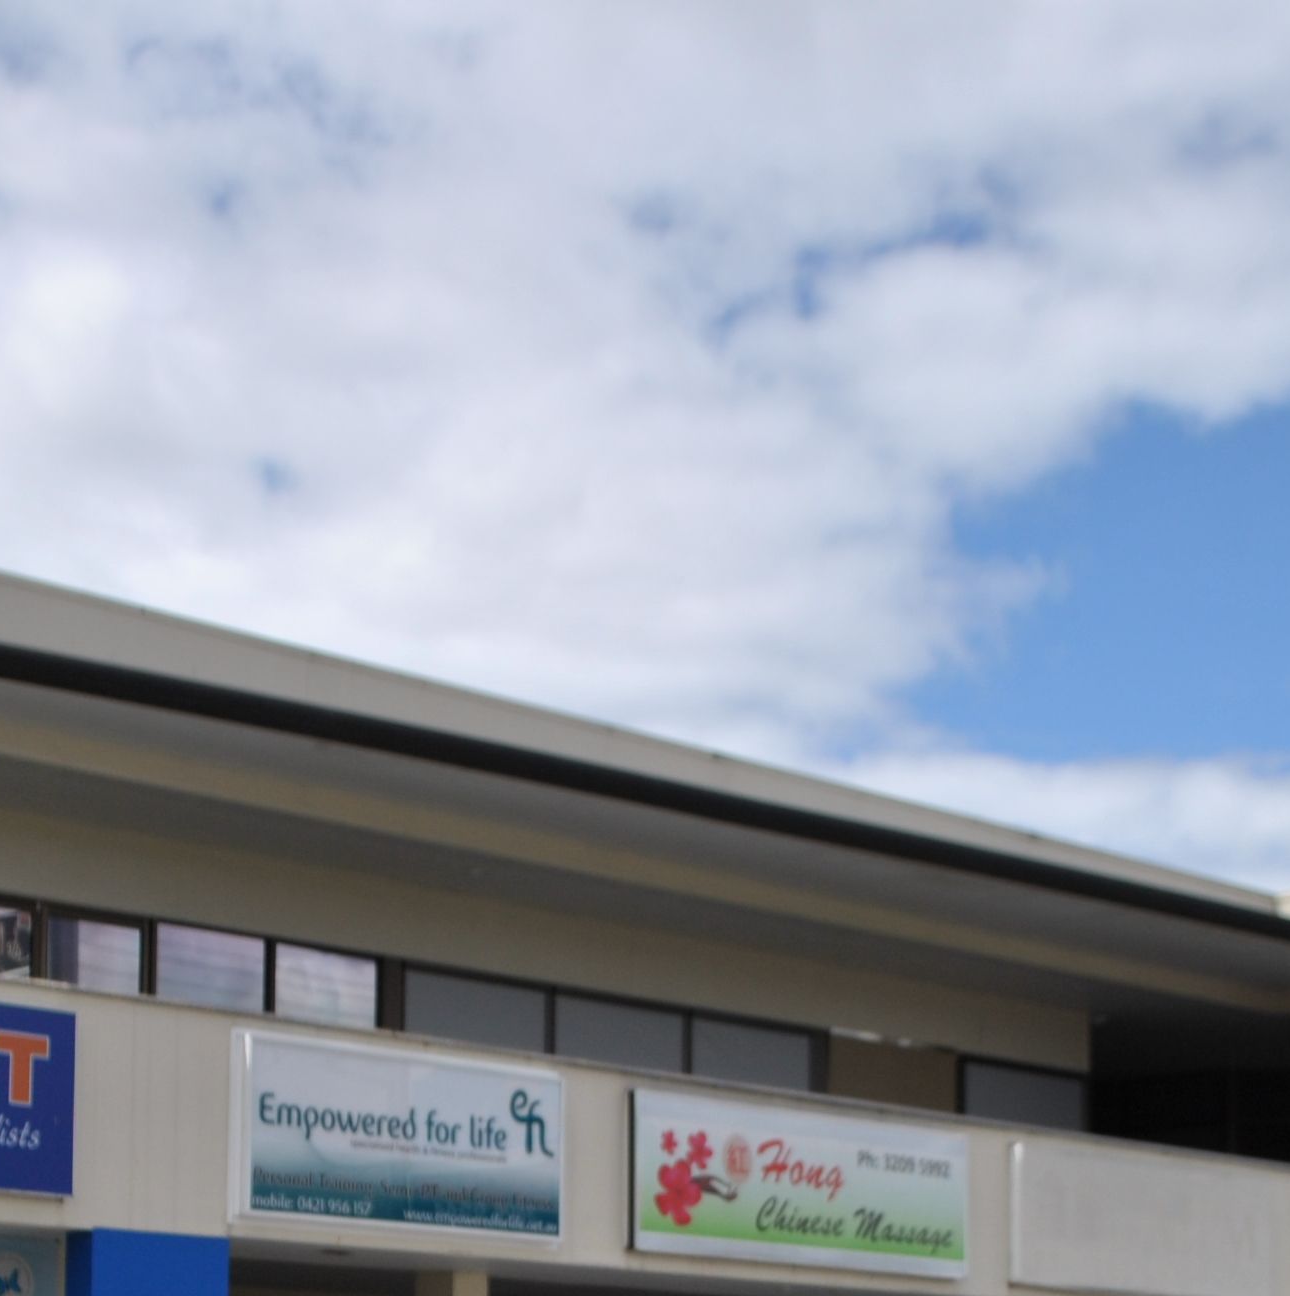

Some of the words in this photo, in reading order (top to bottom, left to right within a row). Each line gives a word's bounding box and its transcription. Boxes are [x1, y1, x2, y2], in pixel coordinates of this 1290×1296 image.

[259, 1091, 417, 1142] Empowered
[425, 1106, 462, 1146] for
[469, 1115, 508, 1152] life
[252, 1166, 314, 1186] Personal
[756, 1139, 845, 1203] Hong
[755, 1195, 845, 1236] Chinese
[853, 1206, 955, 1255] Massage
